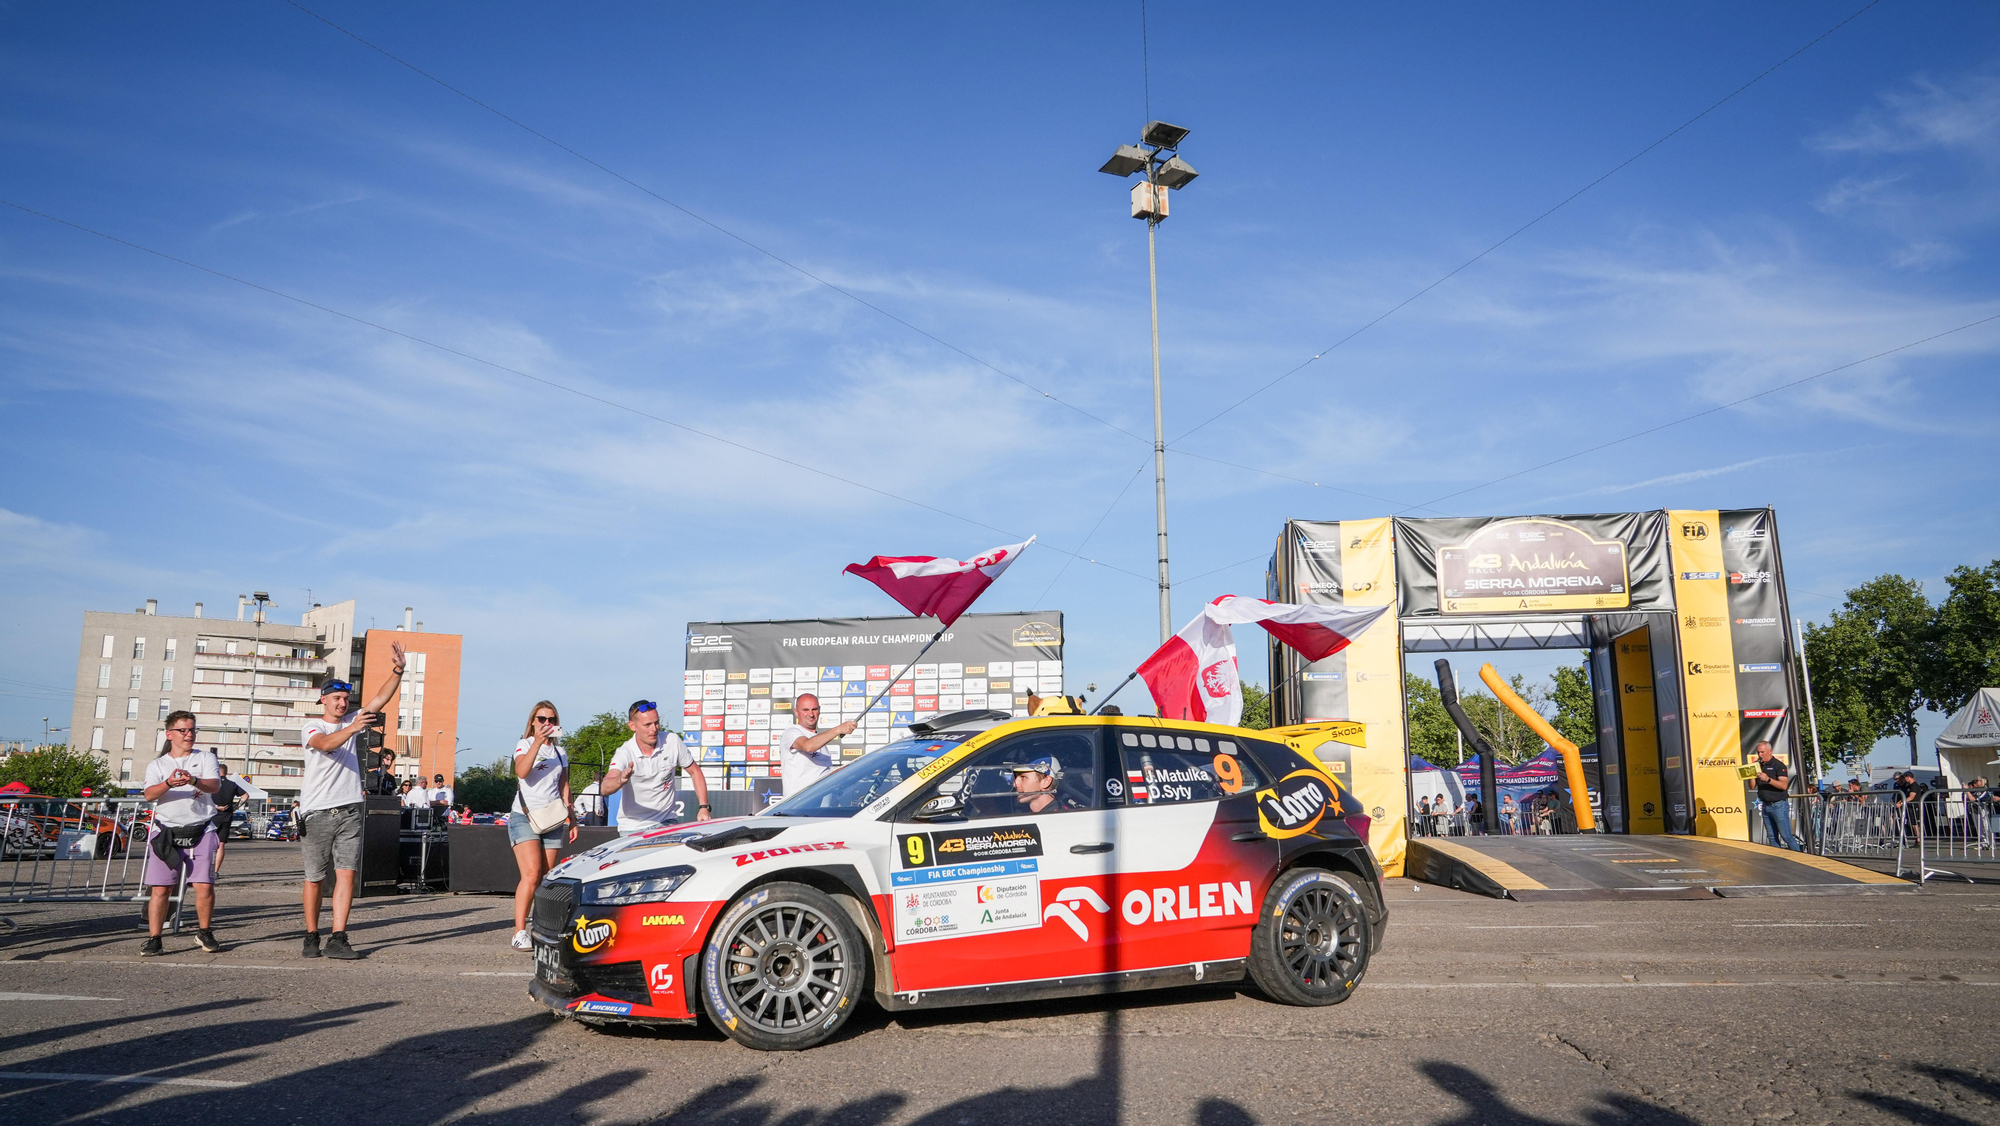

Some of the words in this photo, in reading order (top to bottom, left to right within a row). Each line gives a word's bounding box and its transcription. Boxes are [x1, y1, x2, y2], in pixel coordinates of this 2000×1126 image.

[1468, 554, 1502, 568] 43
[1508, 552, 1589, 572] Andalucía
[1464, 577, 1525, 590] SIERRA
[1529, 576, 1603, 588] MORENA
[690, 635, 732, 646] ERC
[783, 638, 798, 647] FIA
[800, 636, 849, 646] EUROPEAN
[852, 635, 880, 645] RALLY
[918, 756, 954, 780] LAKMA
[1146, 766, 1209, 784] J.Matulka
[1213, 753, 1243, 794] 9
[1151, 785, 1191, 800] D.Syty
[1267, 782, 1324, 826] LOTTO
[938, 838, 965, 853] 43
[965, 836, 992, 844] RALLY
[965, 842, 999, 851] SIERRA
[999, 838, 1037, 848] MORENA
[906, 836, 925, 865] 9
[928, 871, 940, 879] FIA
[942, 868, 956, 878] ERC
[958, 864, 1005, 877] Championship
[923, 890, 957, 899] AYUNTAMIENTO
[996, 884, 1026, 893] Diputación
[1283, 874, 1317, 901] MICHELIN
[930, 898, 952, 906] CÓRDOBA
[1121, 881, 1253, 925] ORLEN
[642, 915, 685, 926] LAKMA
[579, 924, 610, 946] LOTTO
[906, 926, 937, 935] CÓRDOBA
[706, 947, 726, 1010] MICHELIN
